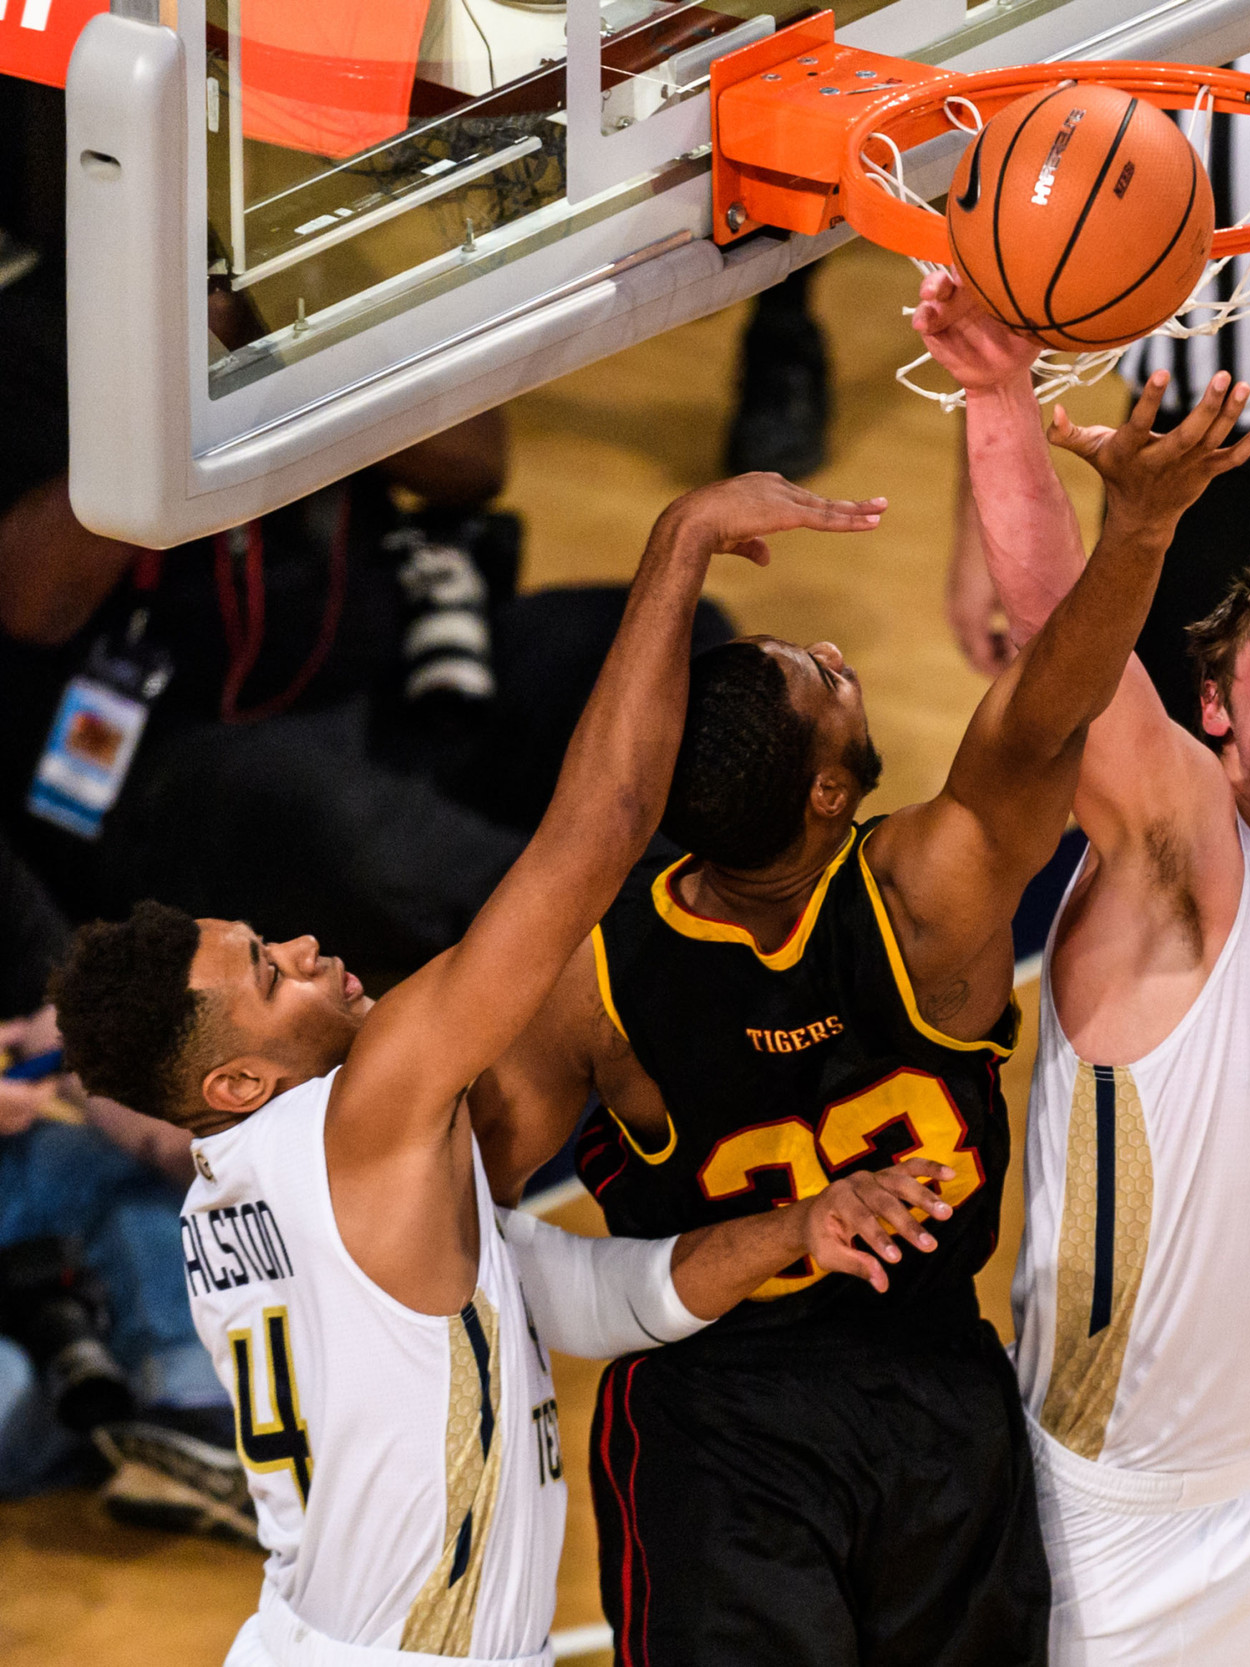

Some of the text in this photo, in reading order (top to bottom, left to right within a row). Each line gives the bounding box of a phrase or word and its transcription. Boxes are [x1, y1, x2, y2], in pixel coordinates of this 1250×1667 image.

[746, 1015, 844, 1053] TIGERS
[180, 1200, 294, 1296] ALSTON
[227, 1305, 314, 1520] 4
